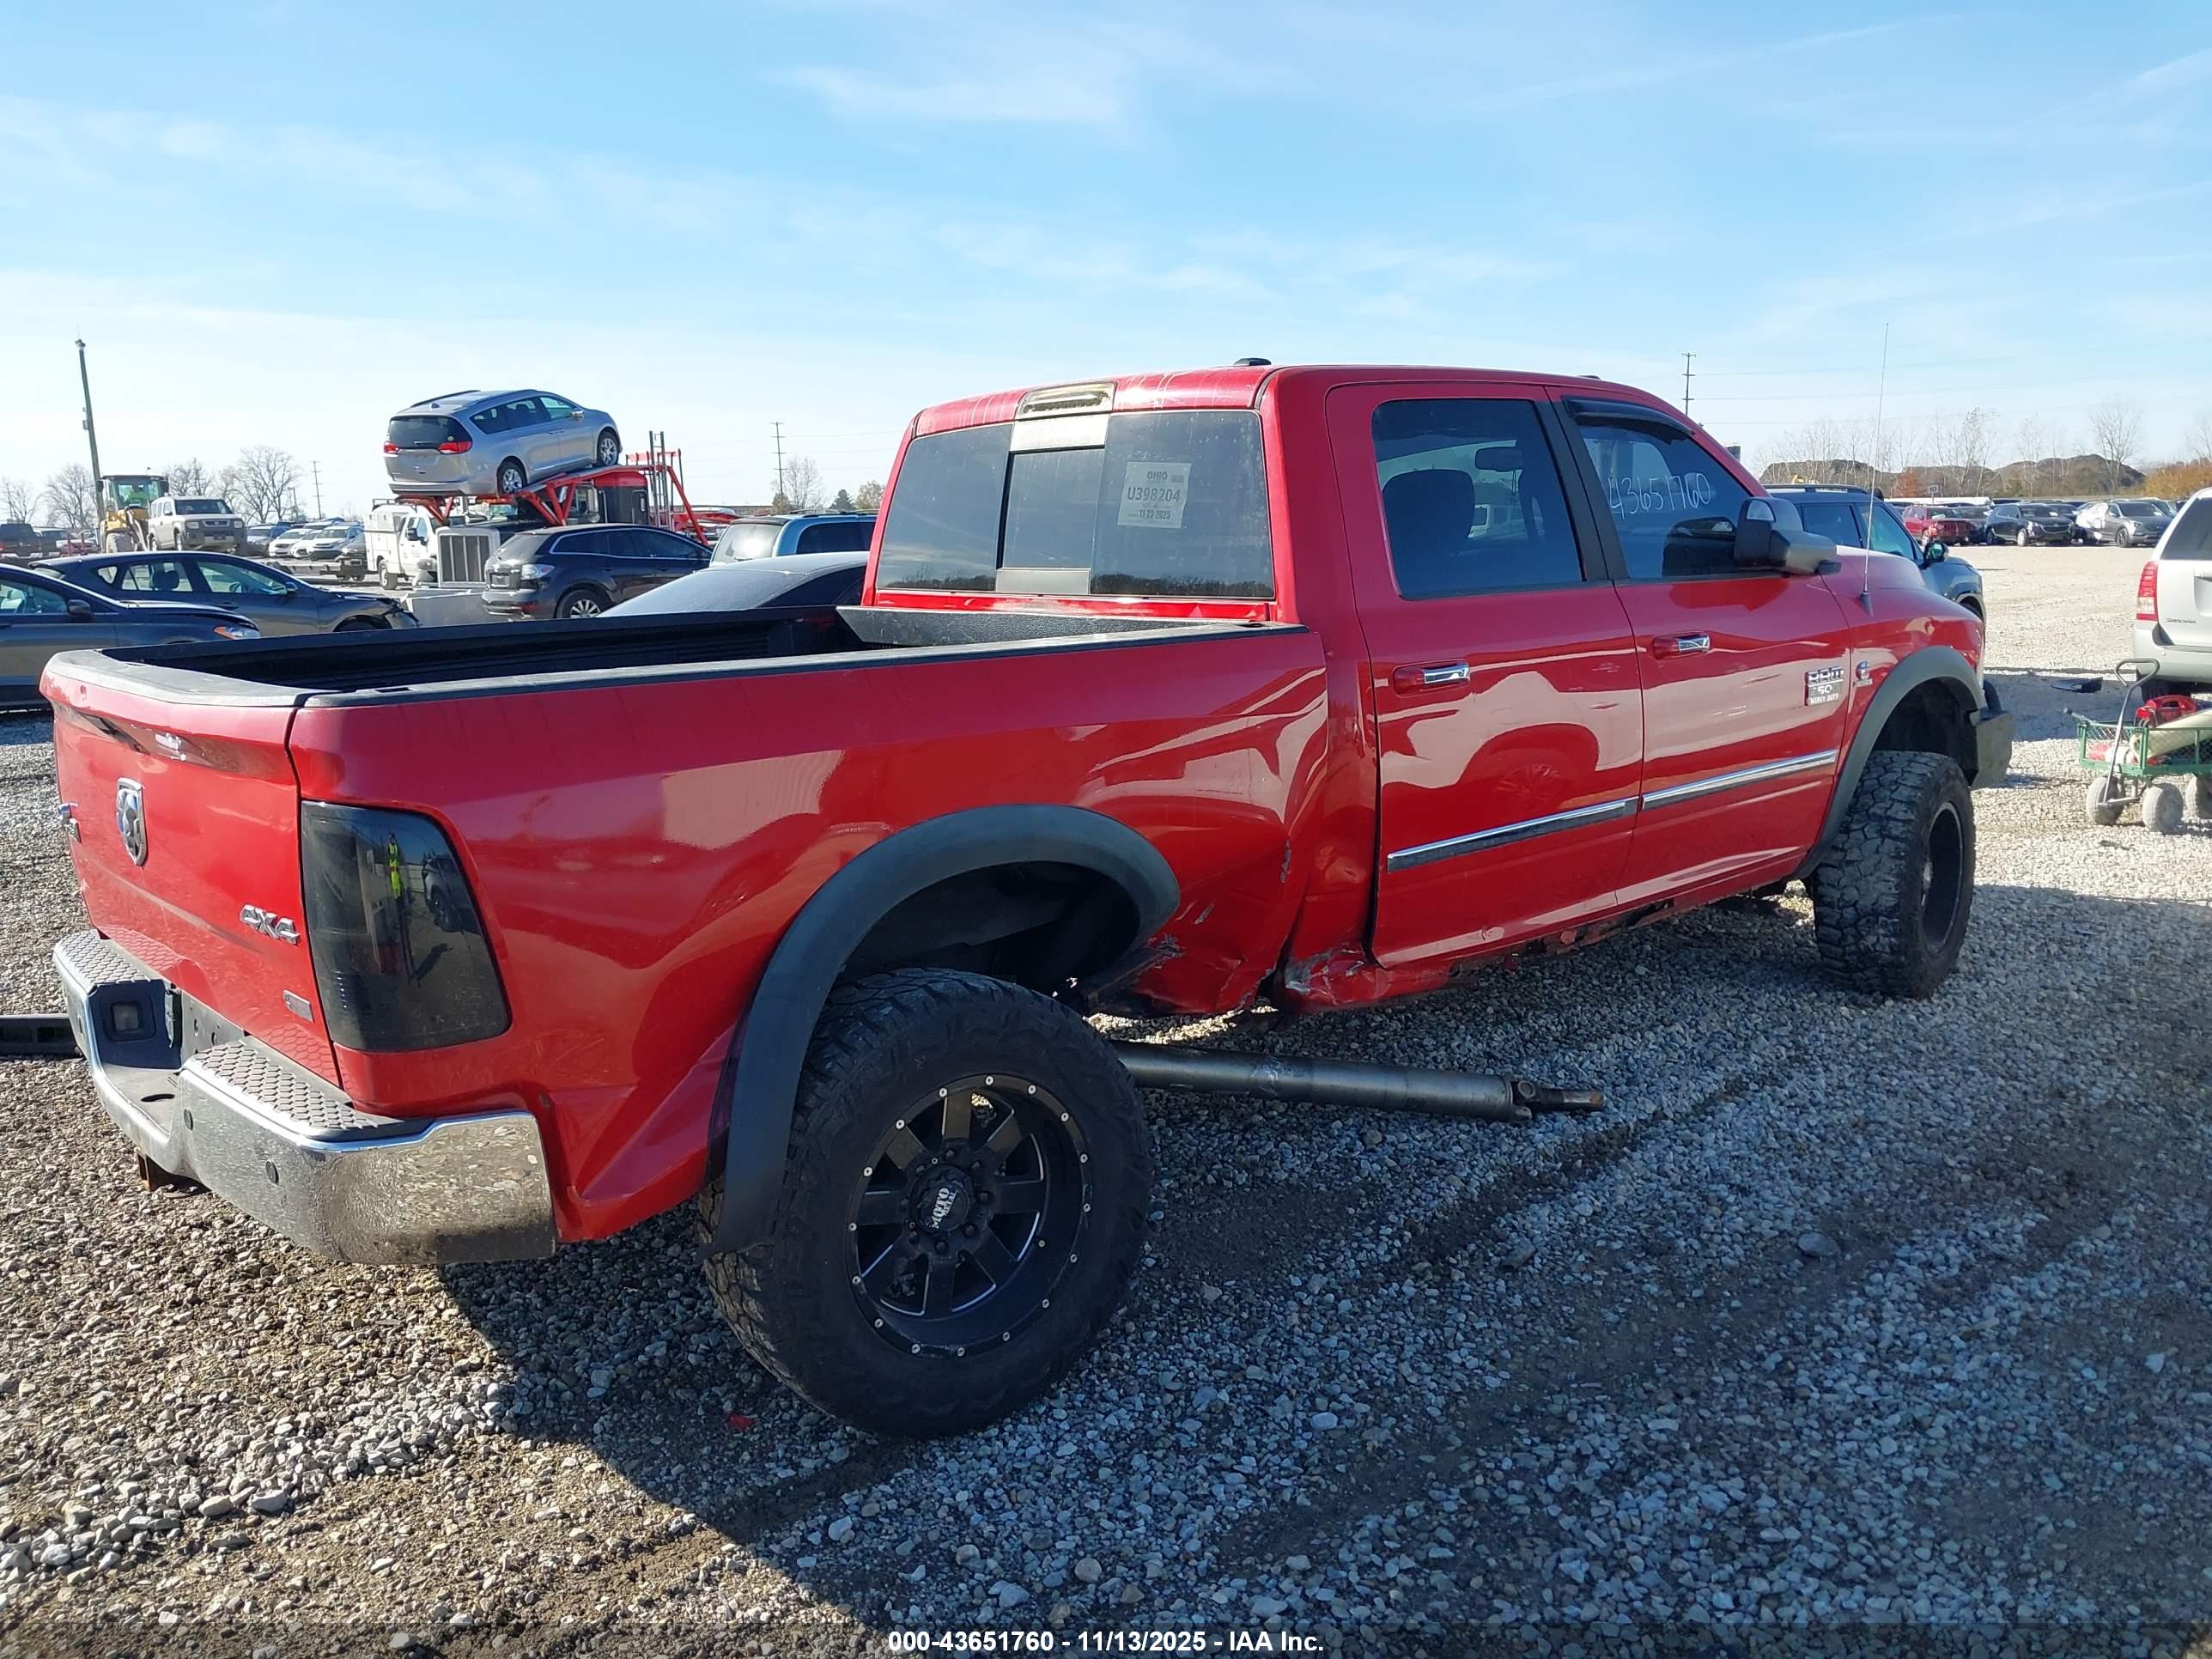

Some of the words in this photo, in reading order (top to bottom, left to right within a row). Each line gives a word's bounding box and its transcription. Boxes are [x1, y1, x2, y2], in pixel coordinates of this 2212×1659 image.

[1146, 471, 1168, 480] OHIO
[1127, 487, 1182, 502] U398204
[1607, 472, 1711, 520] 43651760
